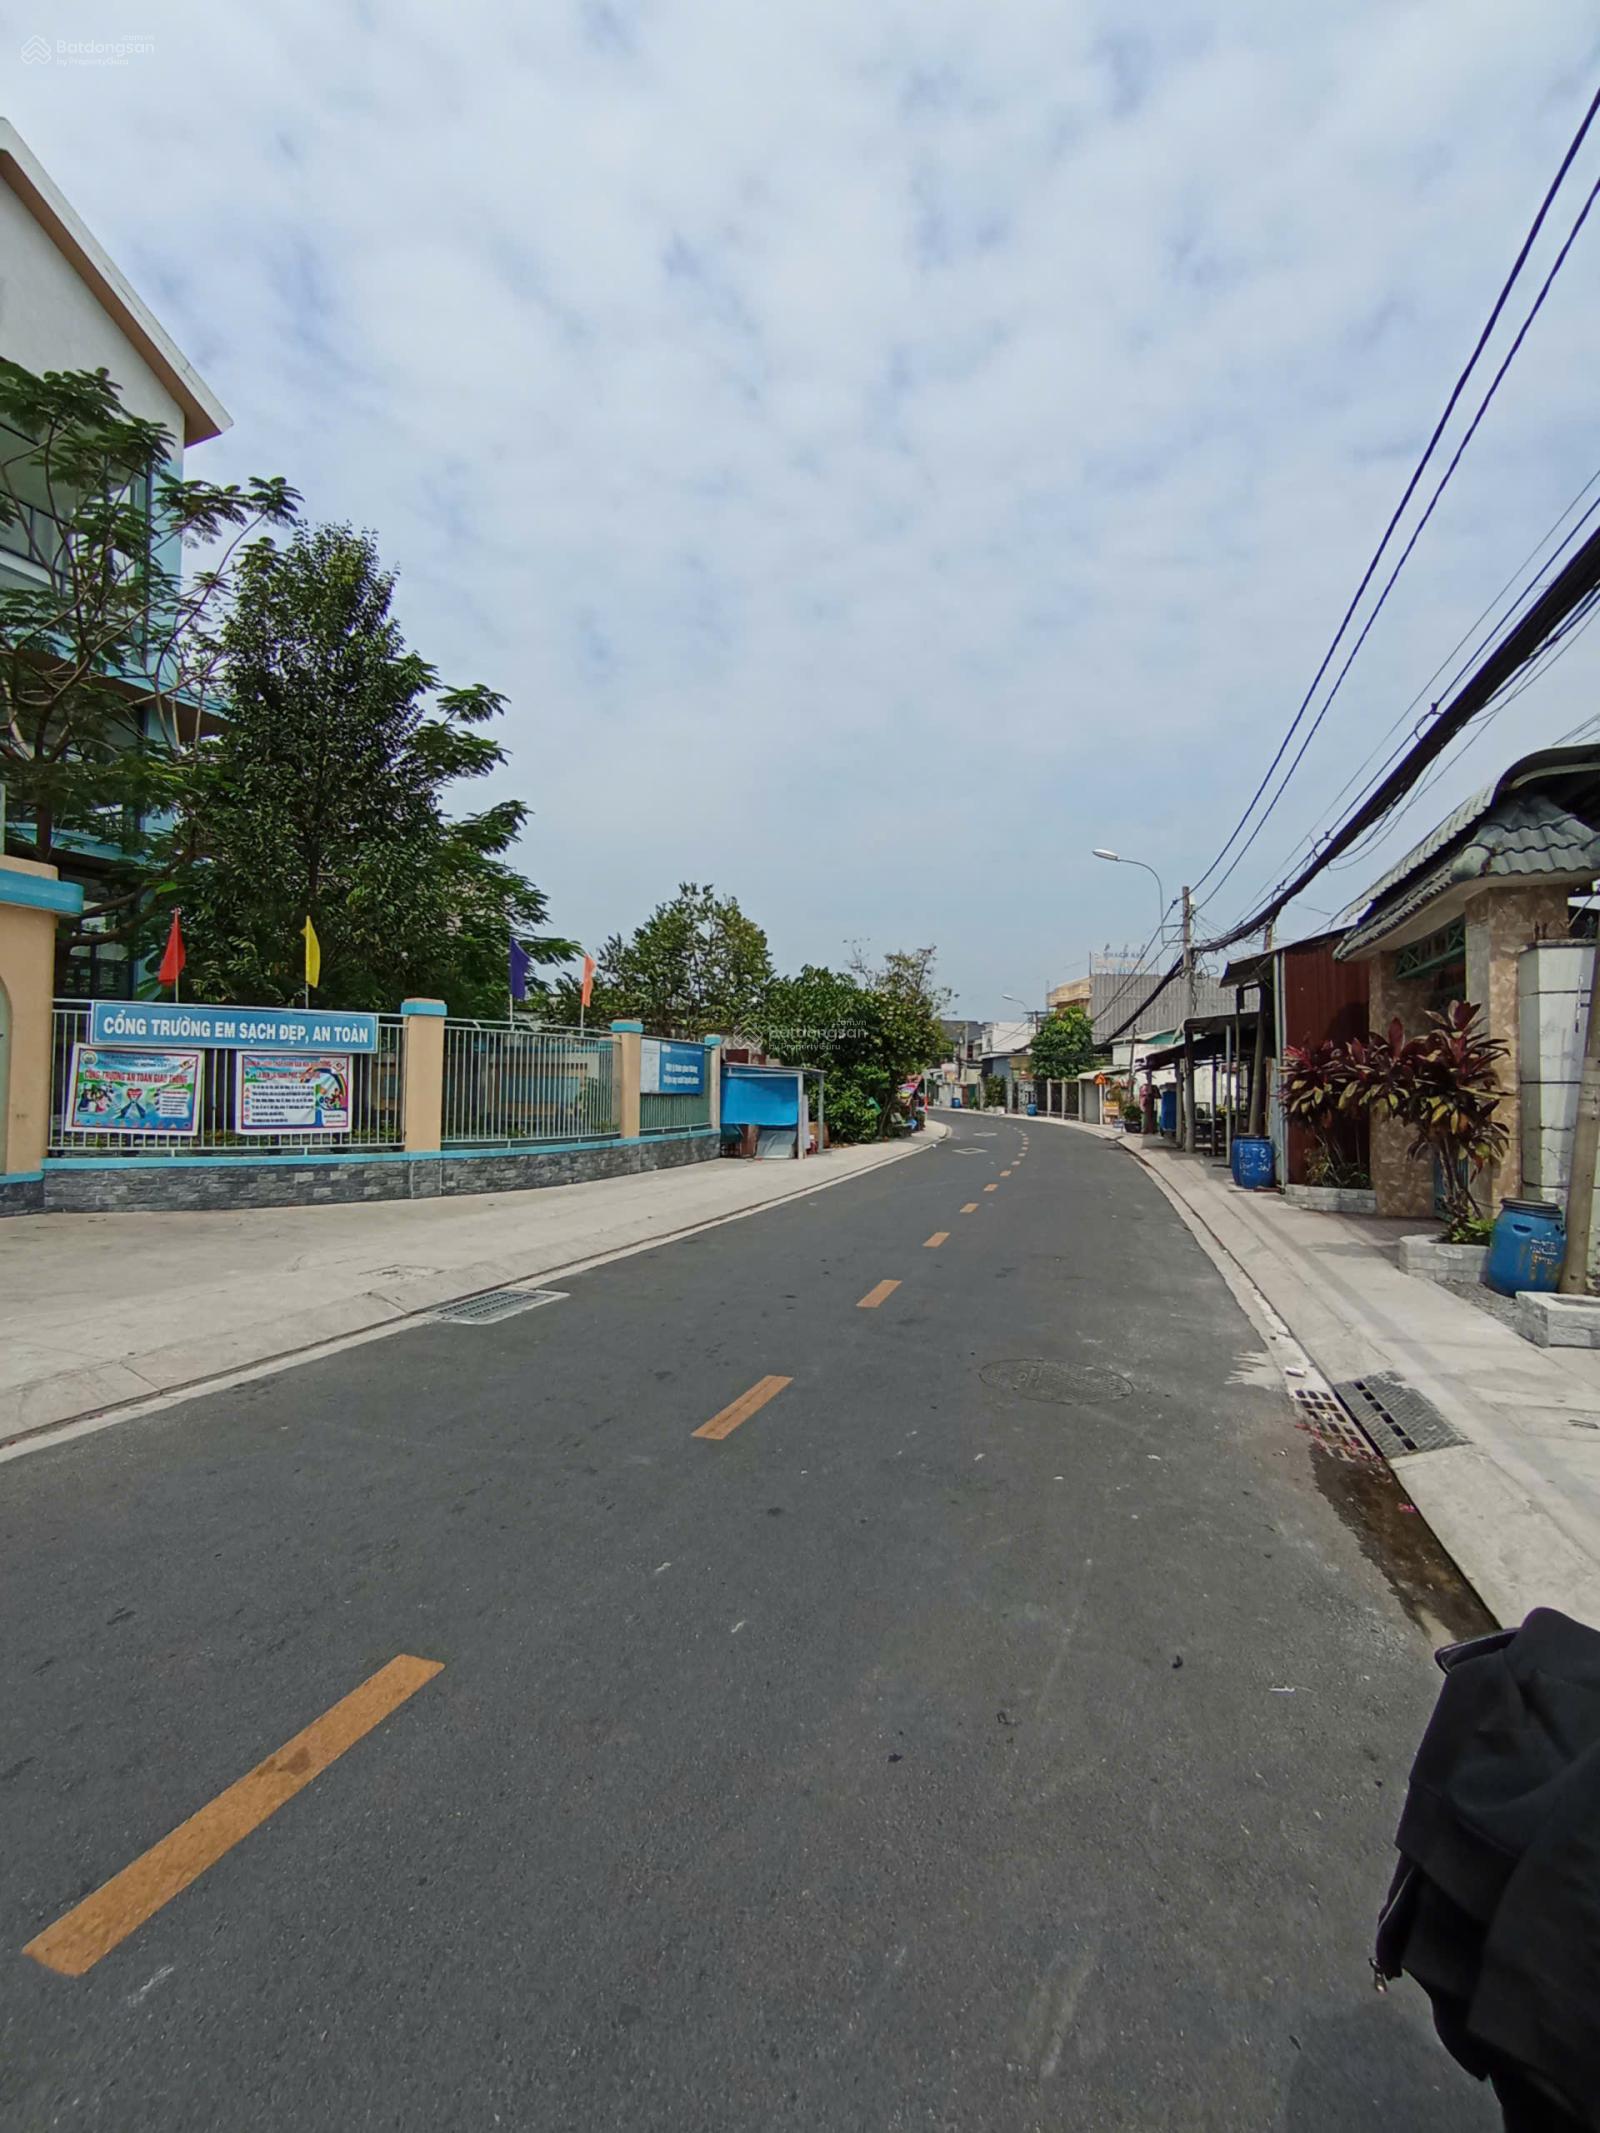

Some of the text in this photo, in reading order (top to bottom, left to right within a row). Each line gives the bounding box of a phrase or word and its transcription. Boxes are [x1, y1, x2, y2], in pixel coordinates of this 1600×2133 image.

[103, 1009, 368, 1044] CỔNG TRƯỜNG EM SẠCH ĐẸP, AN TOÀN
